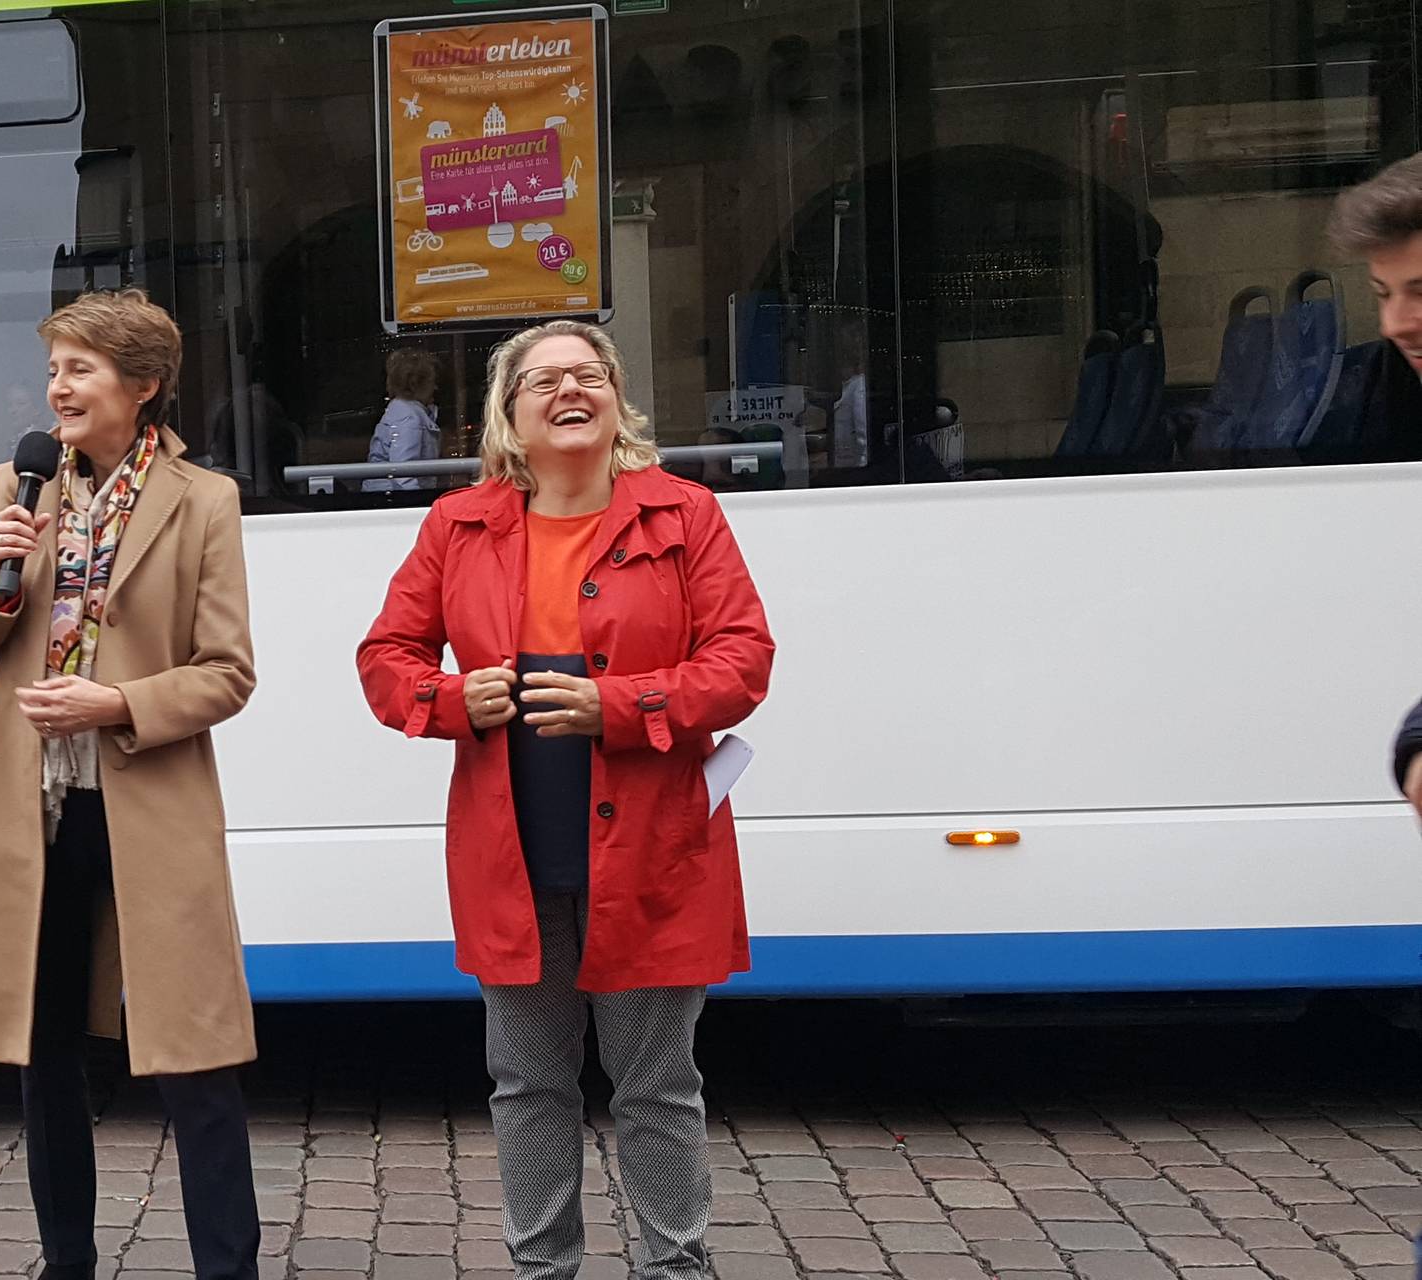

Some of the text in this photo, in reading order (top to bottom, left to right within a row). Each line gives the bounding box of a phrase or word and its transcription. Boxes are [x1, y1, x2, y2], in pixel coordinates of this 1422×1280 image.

[430, 135, 548, 169] münstercard
[542, 242, 569, 261] 20 €
